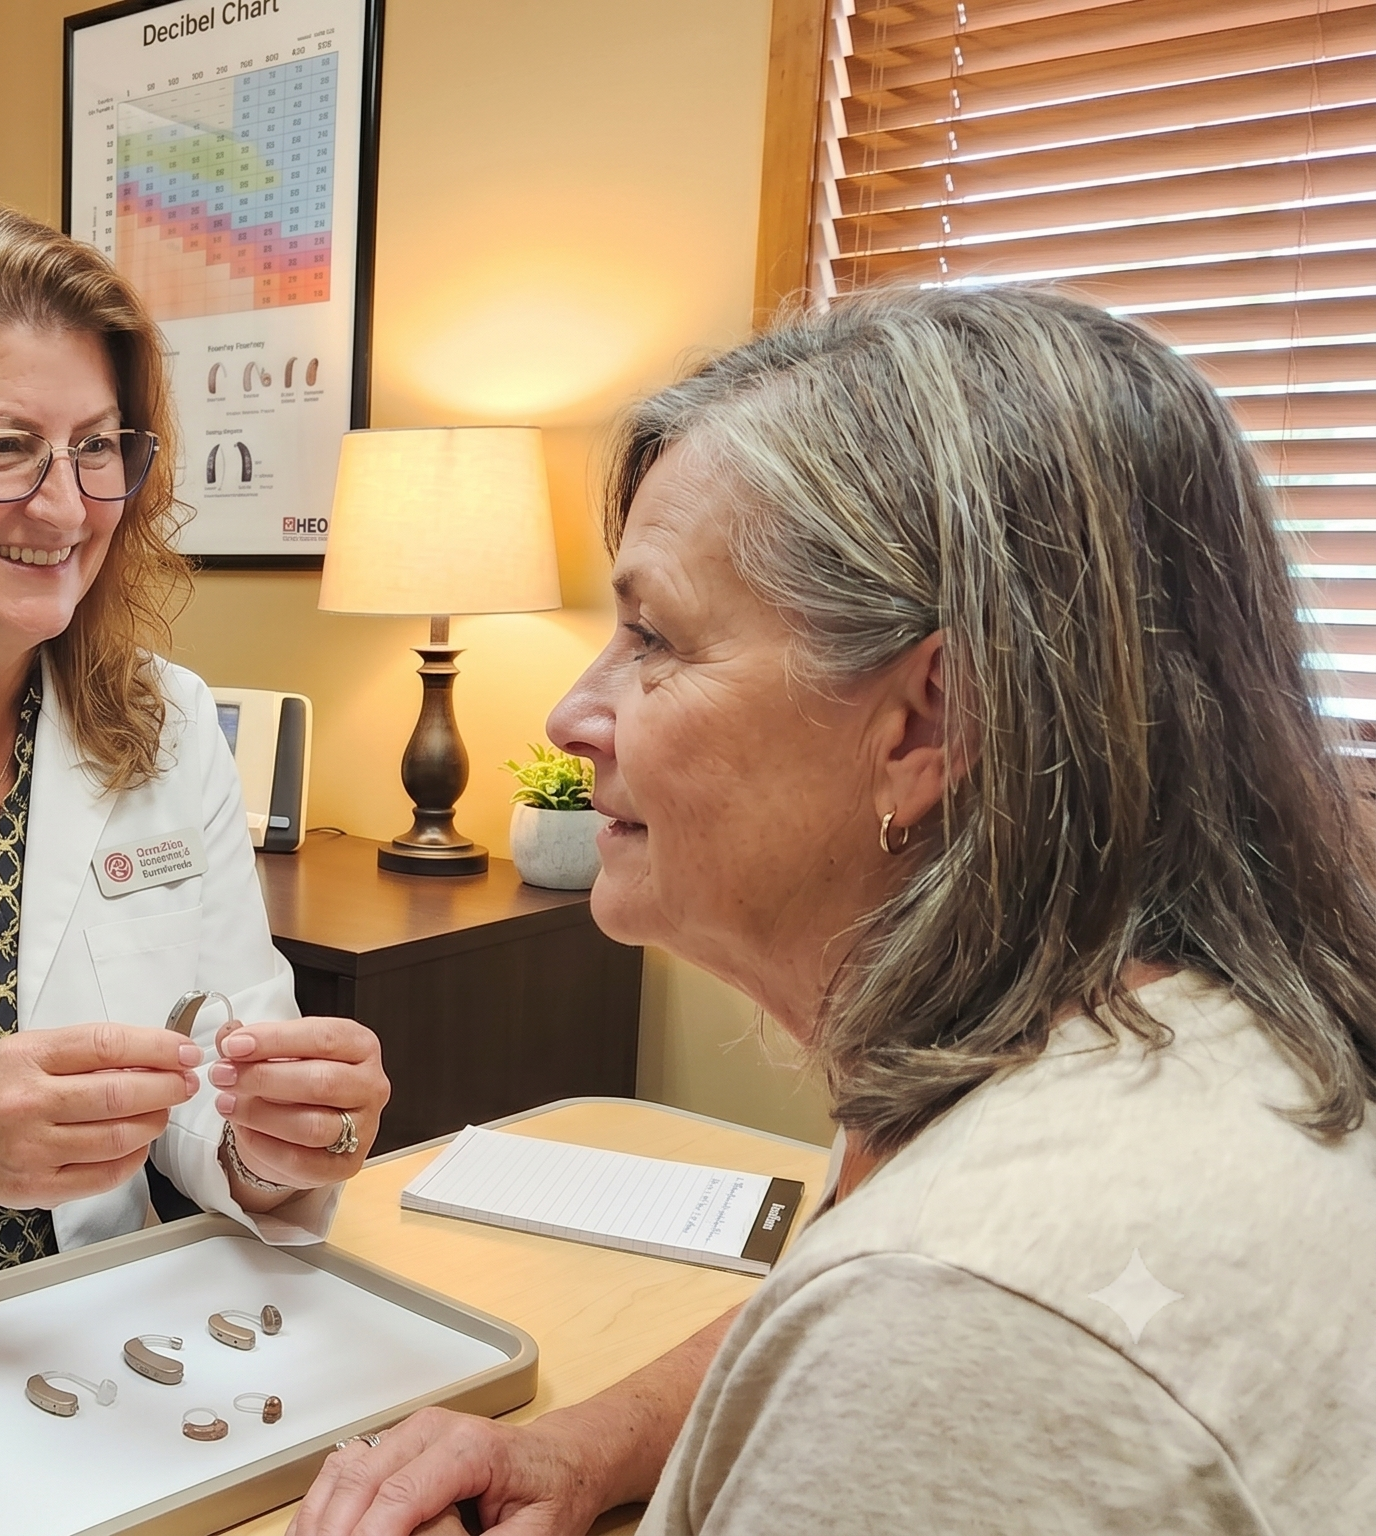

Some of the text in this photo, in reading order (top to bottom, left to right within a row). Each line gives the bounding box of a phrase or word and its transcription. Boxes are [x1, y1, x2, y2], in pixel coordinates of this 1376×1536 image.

[143, 0, 280, 47] Decibel Chart
[296, 518, 328, 533] HEO
